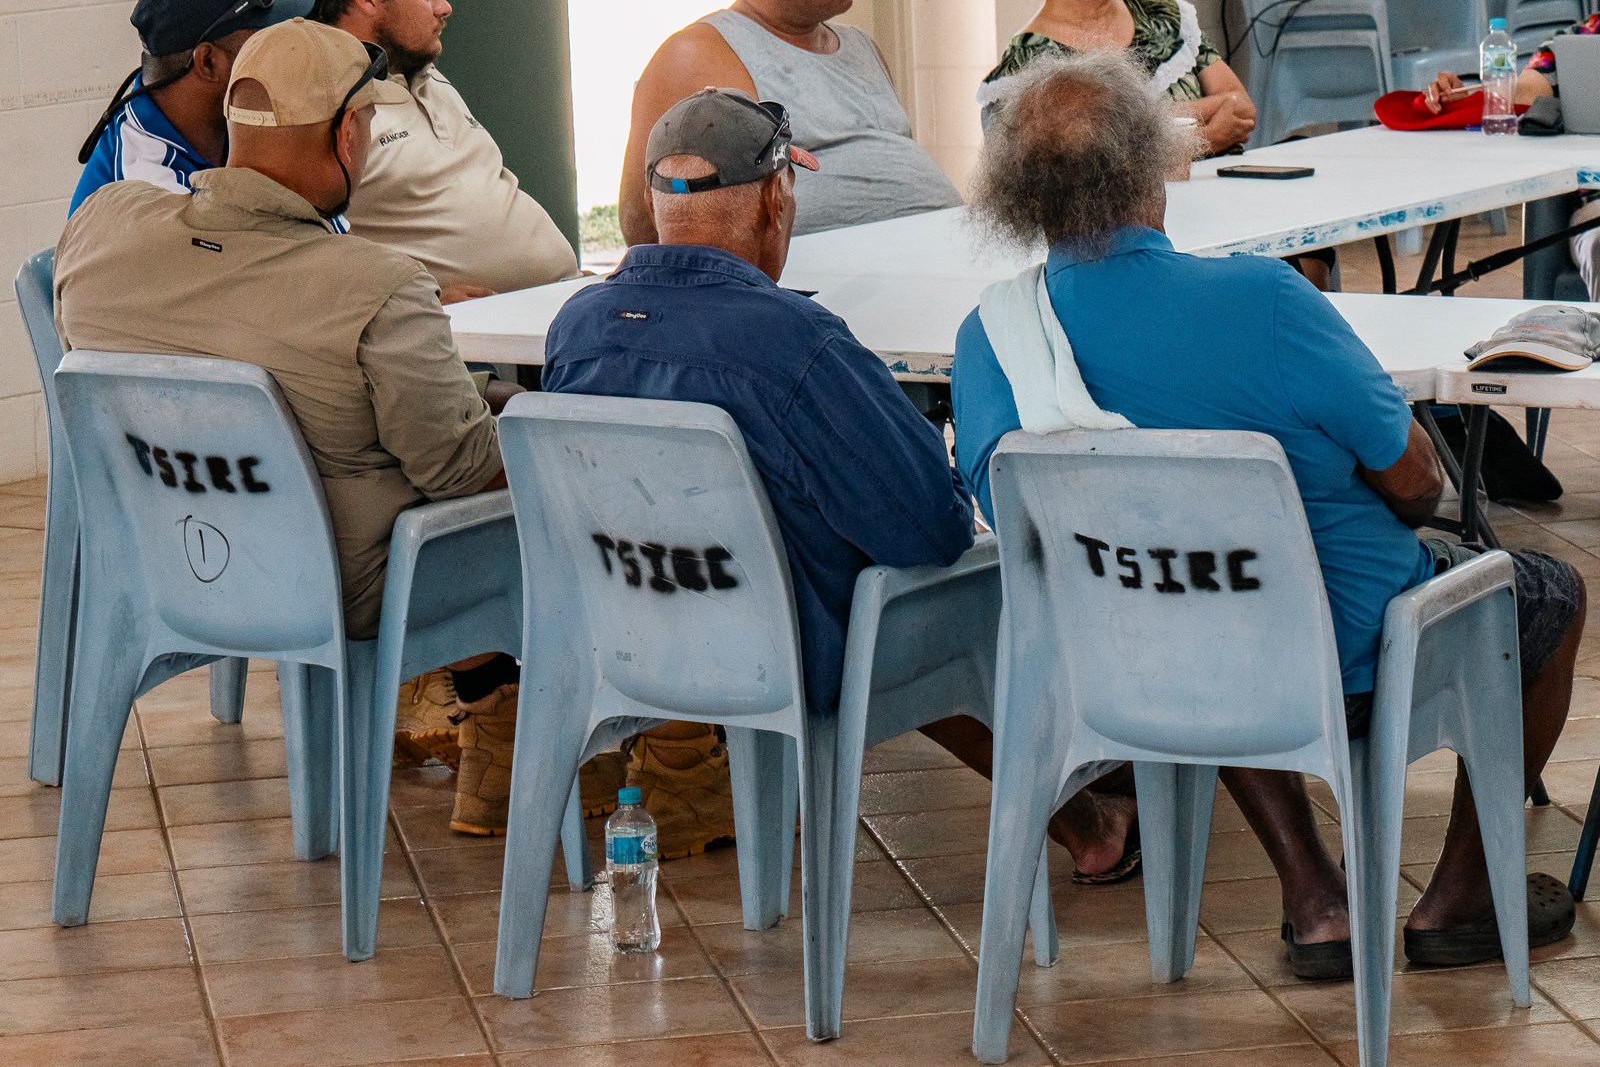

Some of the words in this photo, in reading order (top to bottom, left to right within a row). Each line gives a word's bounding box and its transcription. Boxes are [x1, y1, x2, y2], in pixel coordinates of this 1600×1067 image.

[125, 431, 271, 494] TSIRC
[592, 533, 739, 594] TSIRC
[1074, 532, 1261, 594] TSIRC
